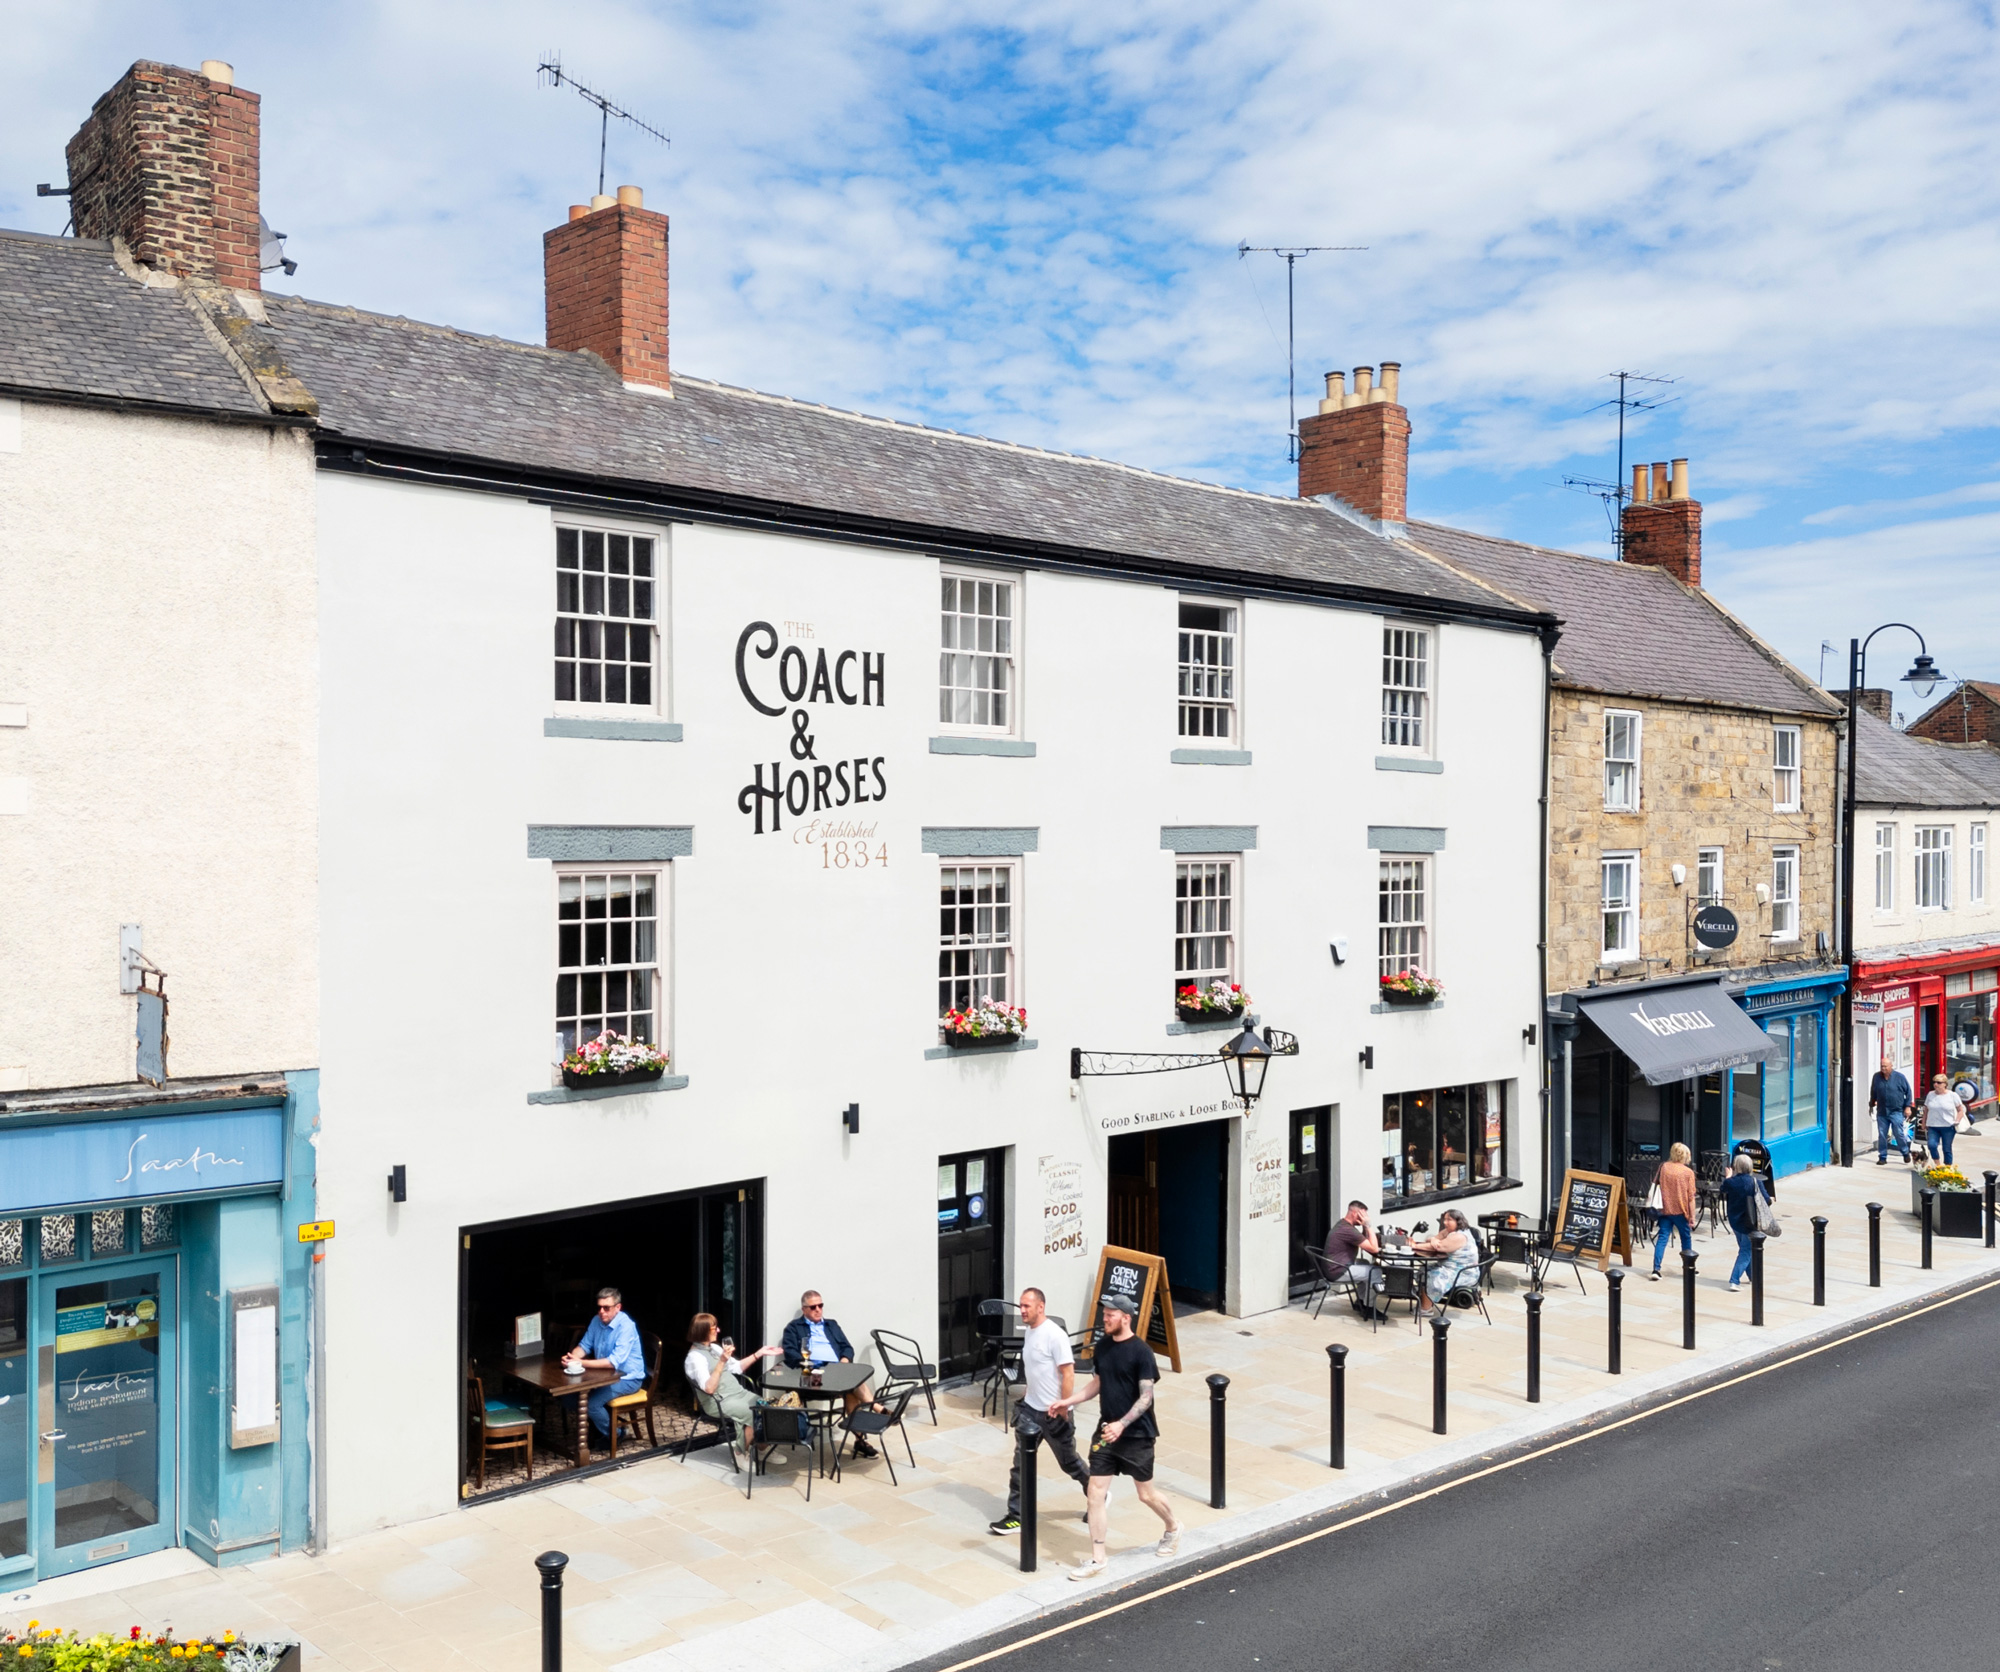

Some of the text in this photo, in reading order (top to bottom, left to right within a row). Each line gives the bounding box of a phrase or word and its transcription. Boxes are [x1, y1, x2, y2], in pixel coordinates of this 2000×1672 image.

[784, 621, 815, 639] THE
[735, 620, 885, 717] COACH
[790, 708, 817, 760] &
[738, 756, 887, 835] HORSES
[793, 819, 878, 844] Established
[821, 840, 888, 869] 1834
[1884, 986, 1910, 1003] SHOPPER
[1629, 1002, 1716, 1037] VERCELLI
[1048, 1168, 1079, 1179] CLASSIC
[1256, 1158, 1282, 1172] CASK
[1044, 1202, 1077, 1219] FOOD
[1573, 1214, 1600, 1227] FOOD
[1044, 1231, 1082, 1255] ROOMS
[1113, 1265, 1138, 1280] OPEN
[1110, 1275, 1138, 1289] DAILY
